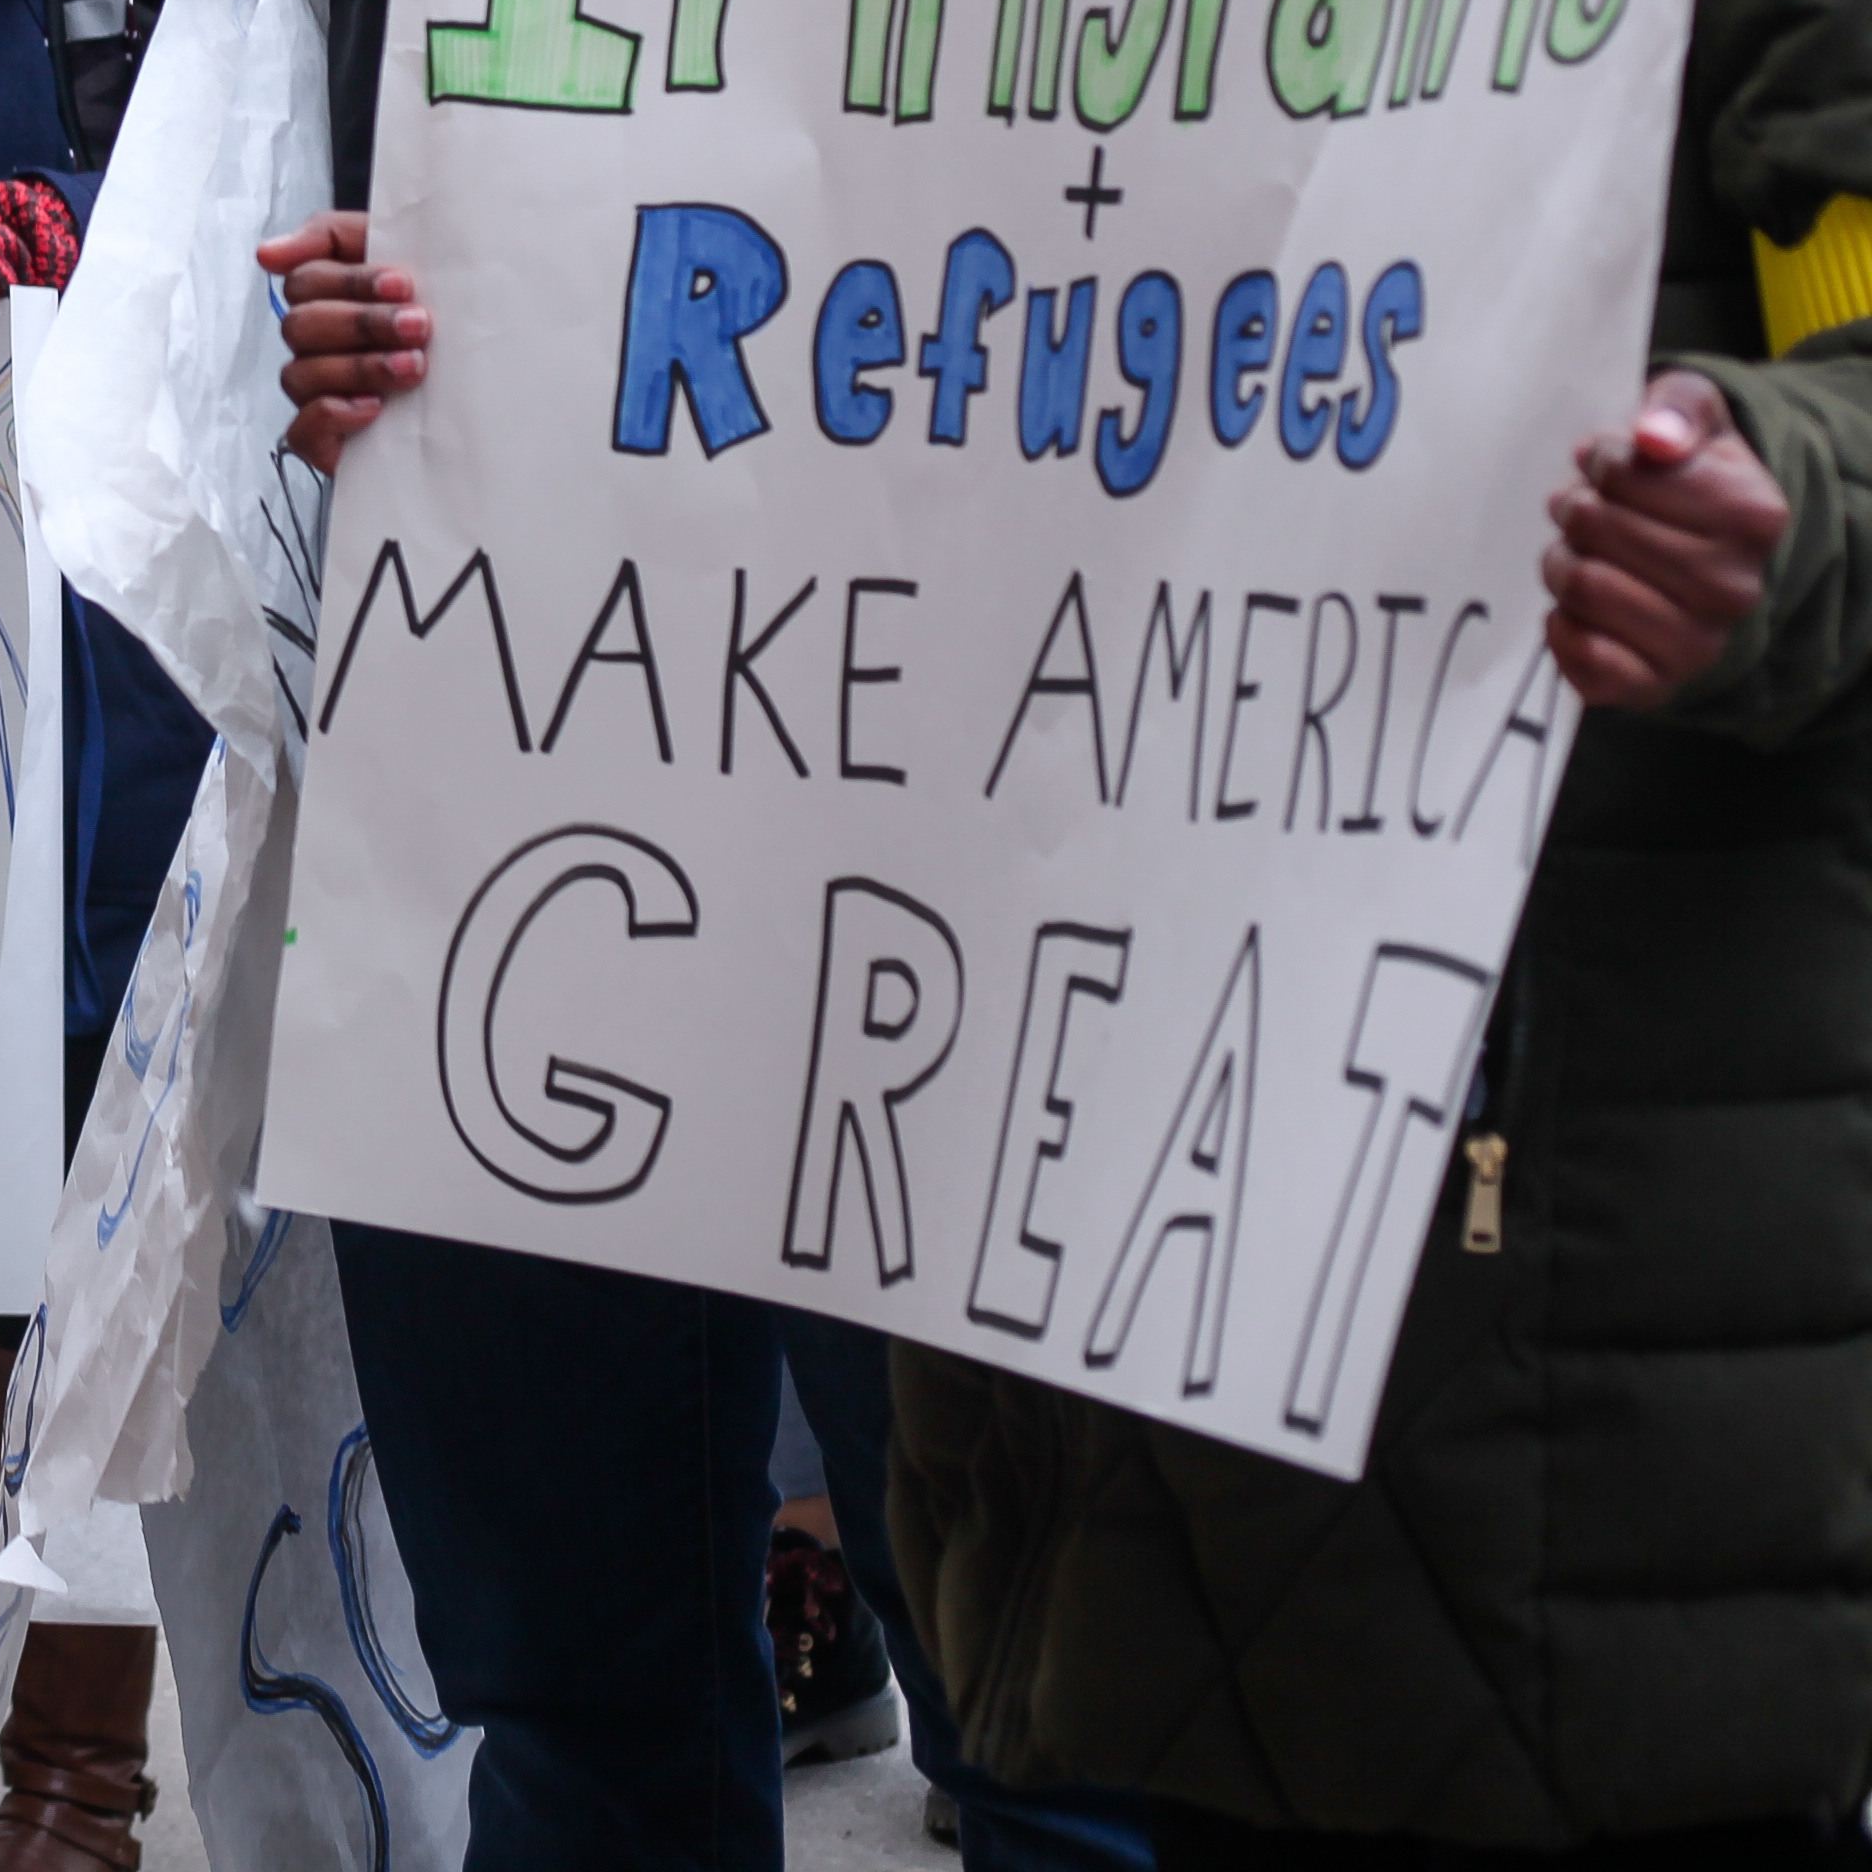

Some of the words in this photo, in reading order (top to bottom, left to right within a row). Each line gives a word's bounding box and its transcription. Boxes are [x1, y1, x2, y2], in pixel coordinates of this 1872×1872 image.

[612, 202, 1424, 499] Refugees
[316, 539, 919, 787] MAKE
[983, 569, 1562, 870] AMERICA
[437, 823, 1498, 1437] GREAT
